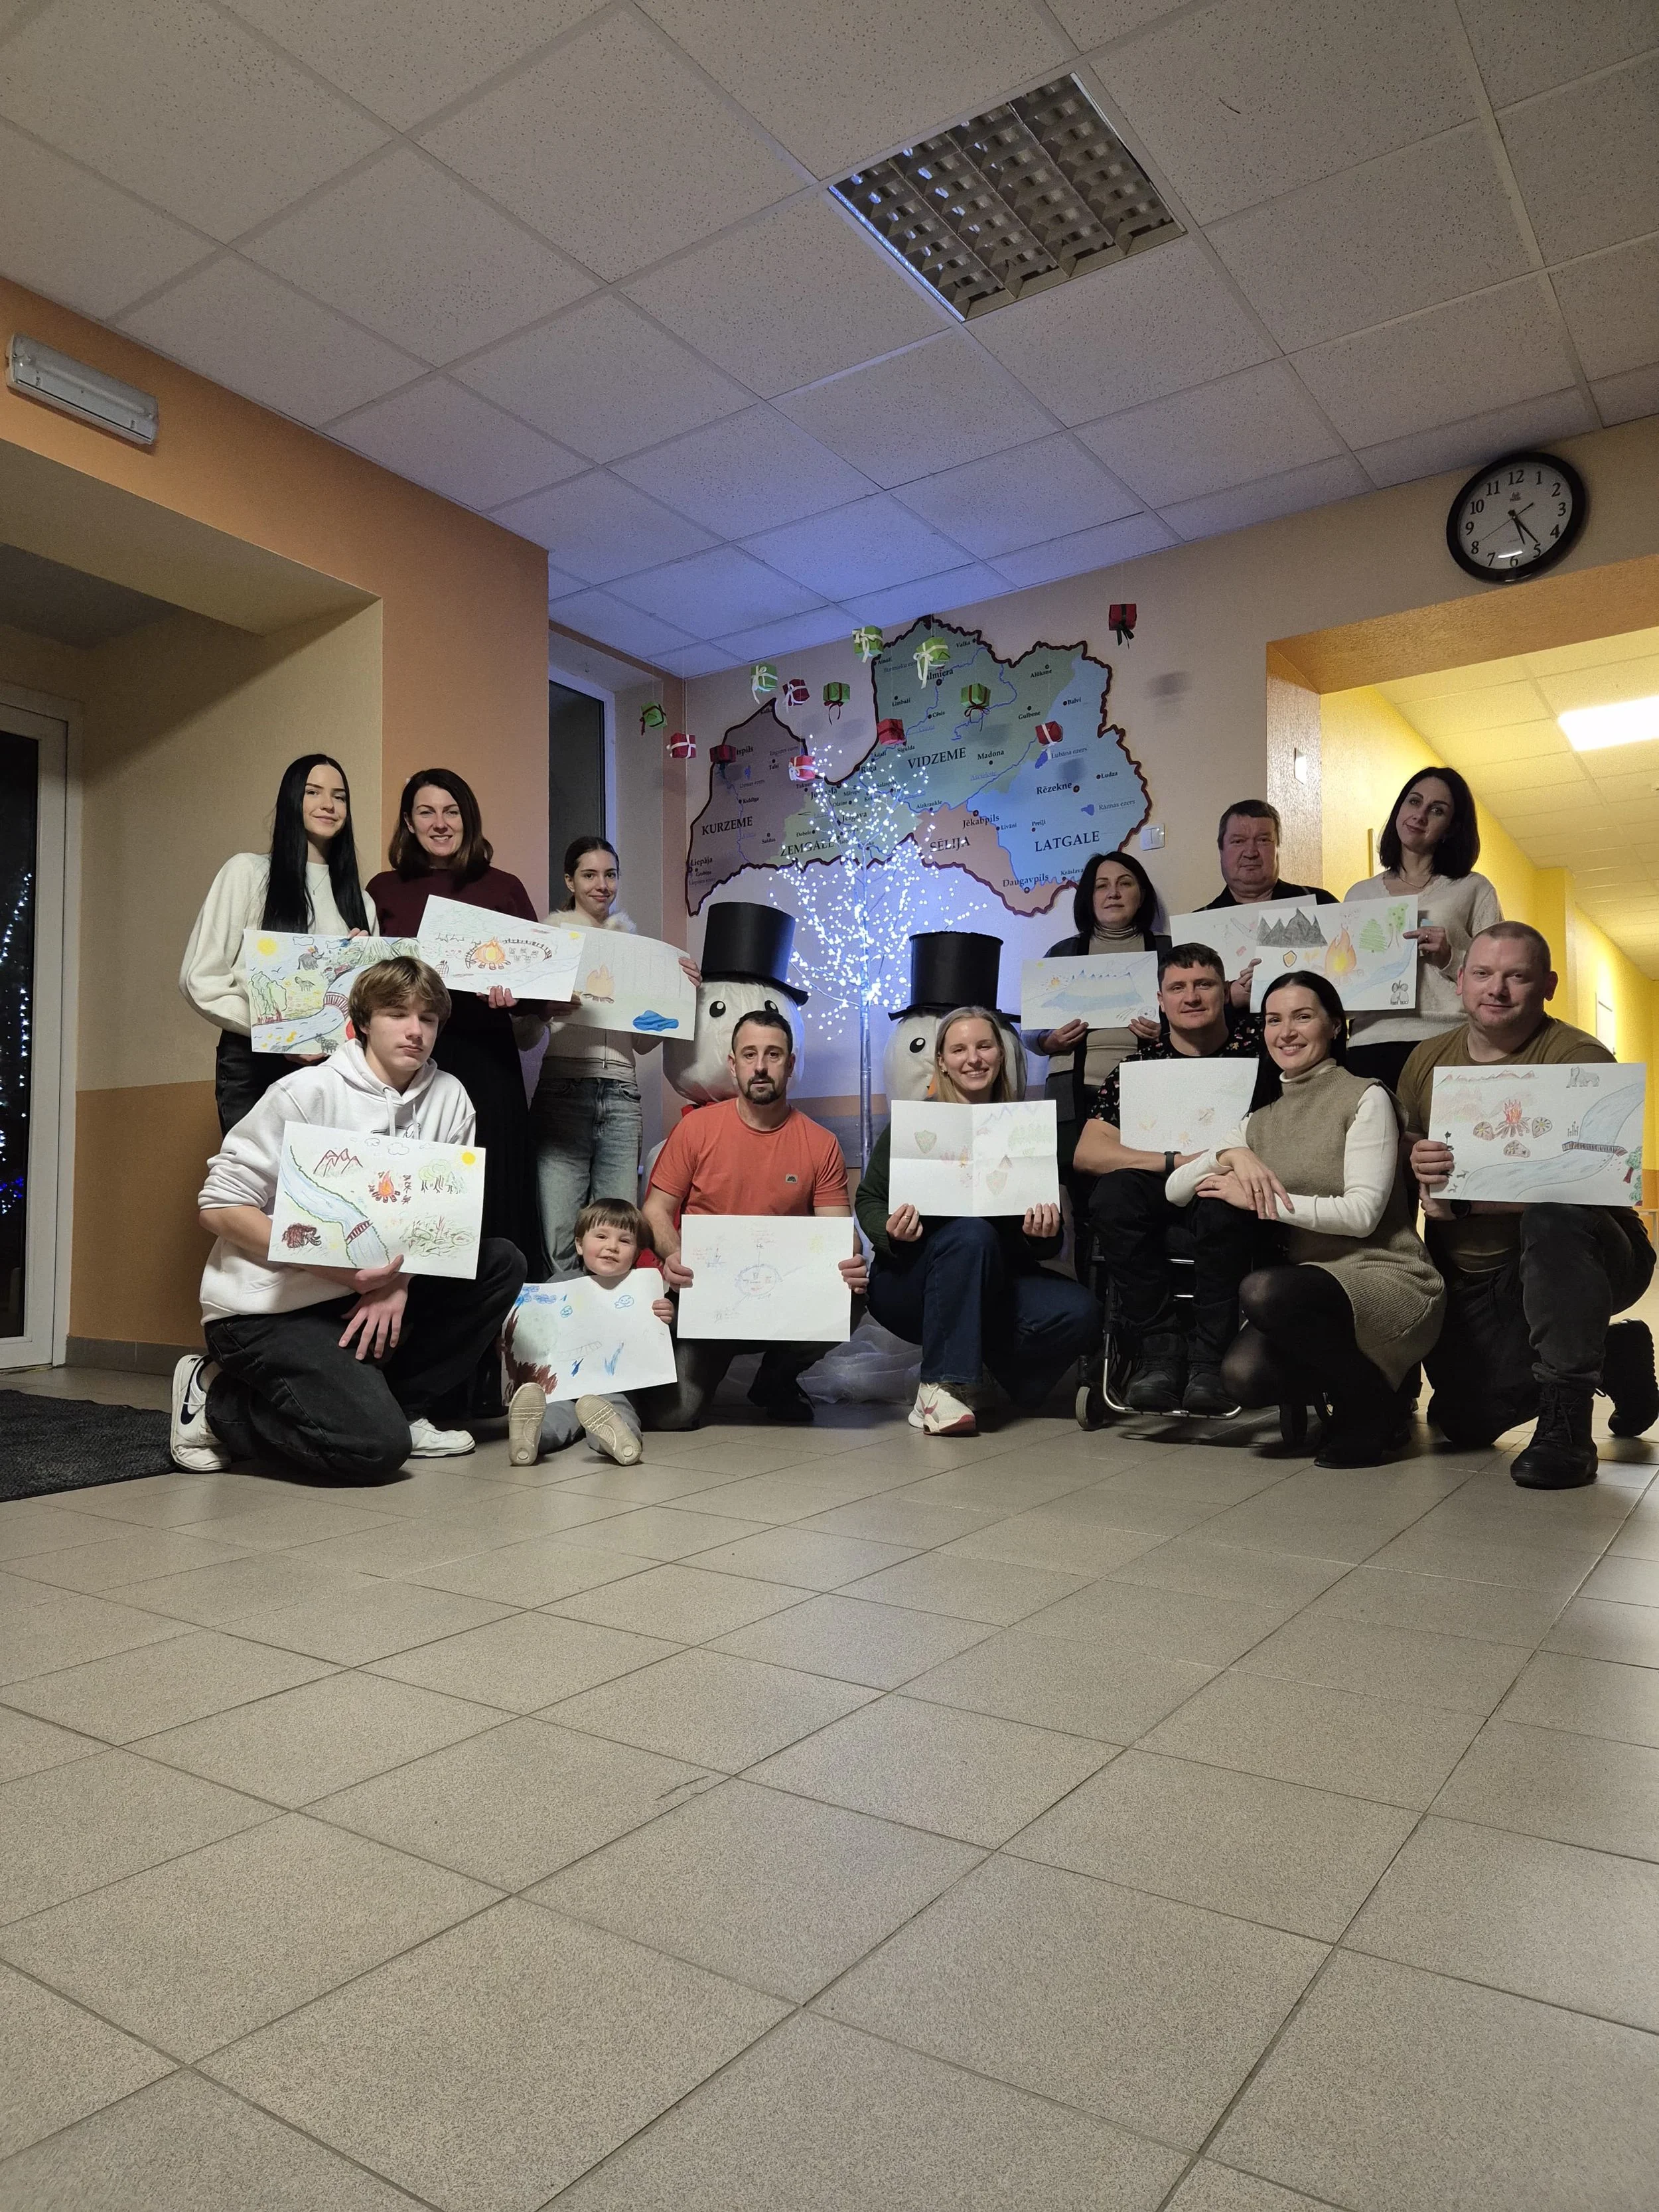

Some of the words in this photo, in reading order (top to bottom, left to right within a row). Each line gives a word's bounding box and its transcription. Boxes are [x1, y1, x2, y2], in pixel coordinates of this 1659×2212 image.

[1508, 469, 1524, 486] 12
[1536, 471, 1543, 485] 1
[1486, 480, 1500, 496] 11
[1551, 482, 1561, 497] 2
[1470, 499, 1484, 515] 10
[1557, 502, 1566, 516] 3
[1465, 521, 1475, 536] 9
[1550, 524, 1560, 538] 4
[1471, 541, 1479, 555] 8
[1533, 542, 1541, 558] 5
[1486, 552, 1496, 567] 7
[1510, 555, 1519, 567] 6
[1067, 697, 1082, 705] Balvi
[1018, 711, 1041, 720] Gulbene
[897, 745, 915, 753] Sigulda
[977, 750, 1005, 761] Madona
[1051, 749, 1072, 759] Lubāna
[907, 747, 966, 769] VIDZEME
[1037, 782, 1072, 795] Rēzekne
[916, 800, 943, 809] Aizkraukle
[701, 816, 753, 836] KURZEME
[962, 814, 999, 829] Jēkabpils
[780, 837, 835, 857] ZEMGALE
[930, 836, 970, 853] SĒLIJA
[1035, 831, 1100, 852] LATGALE
[1003, 873, 1049, 887] Daugavpils
